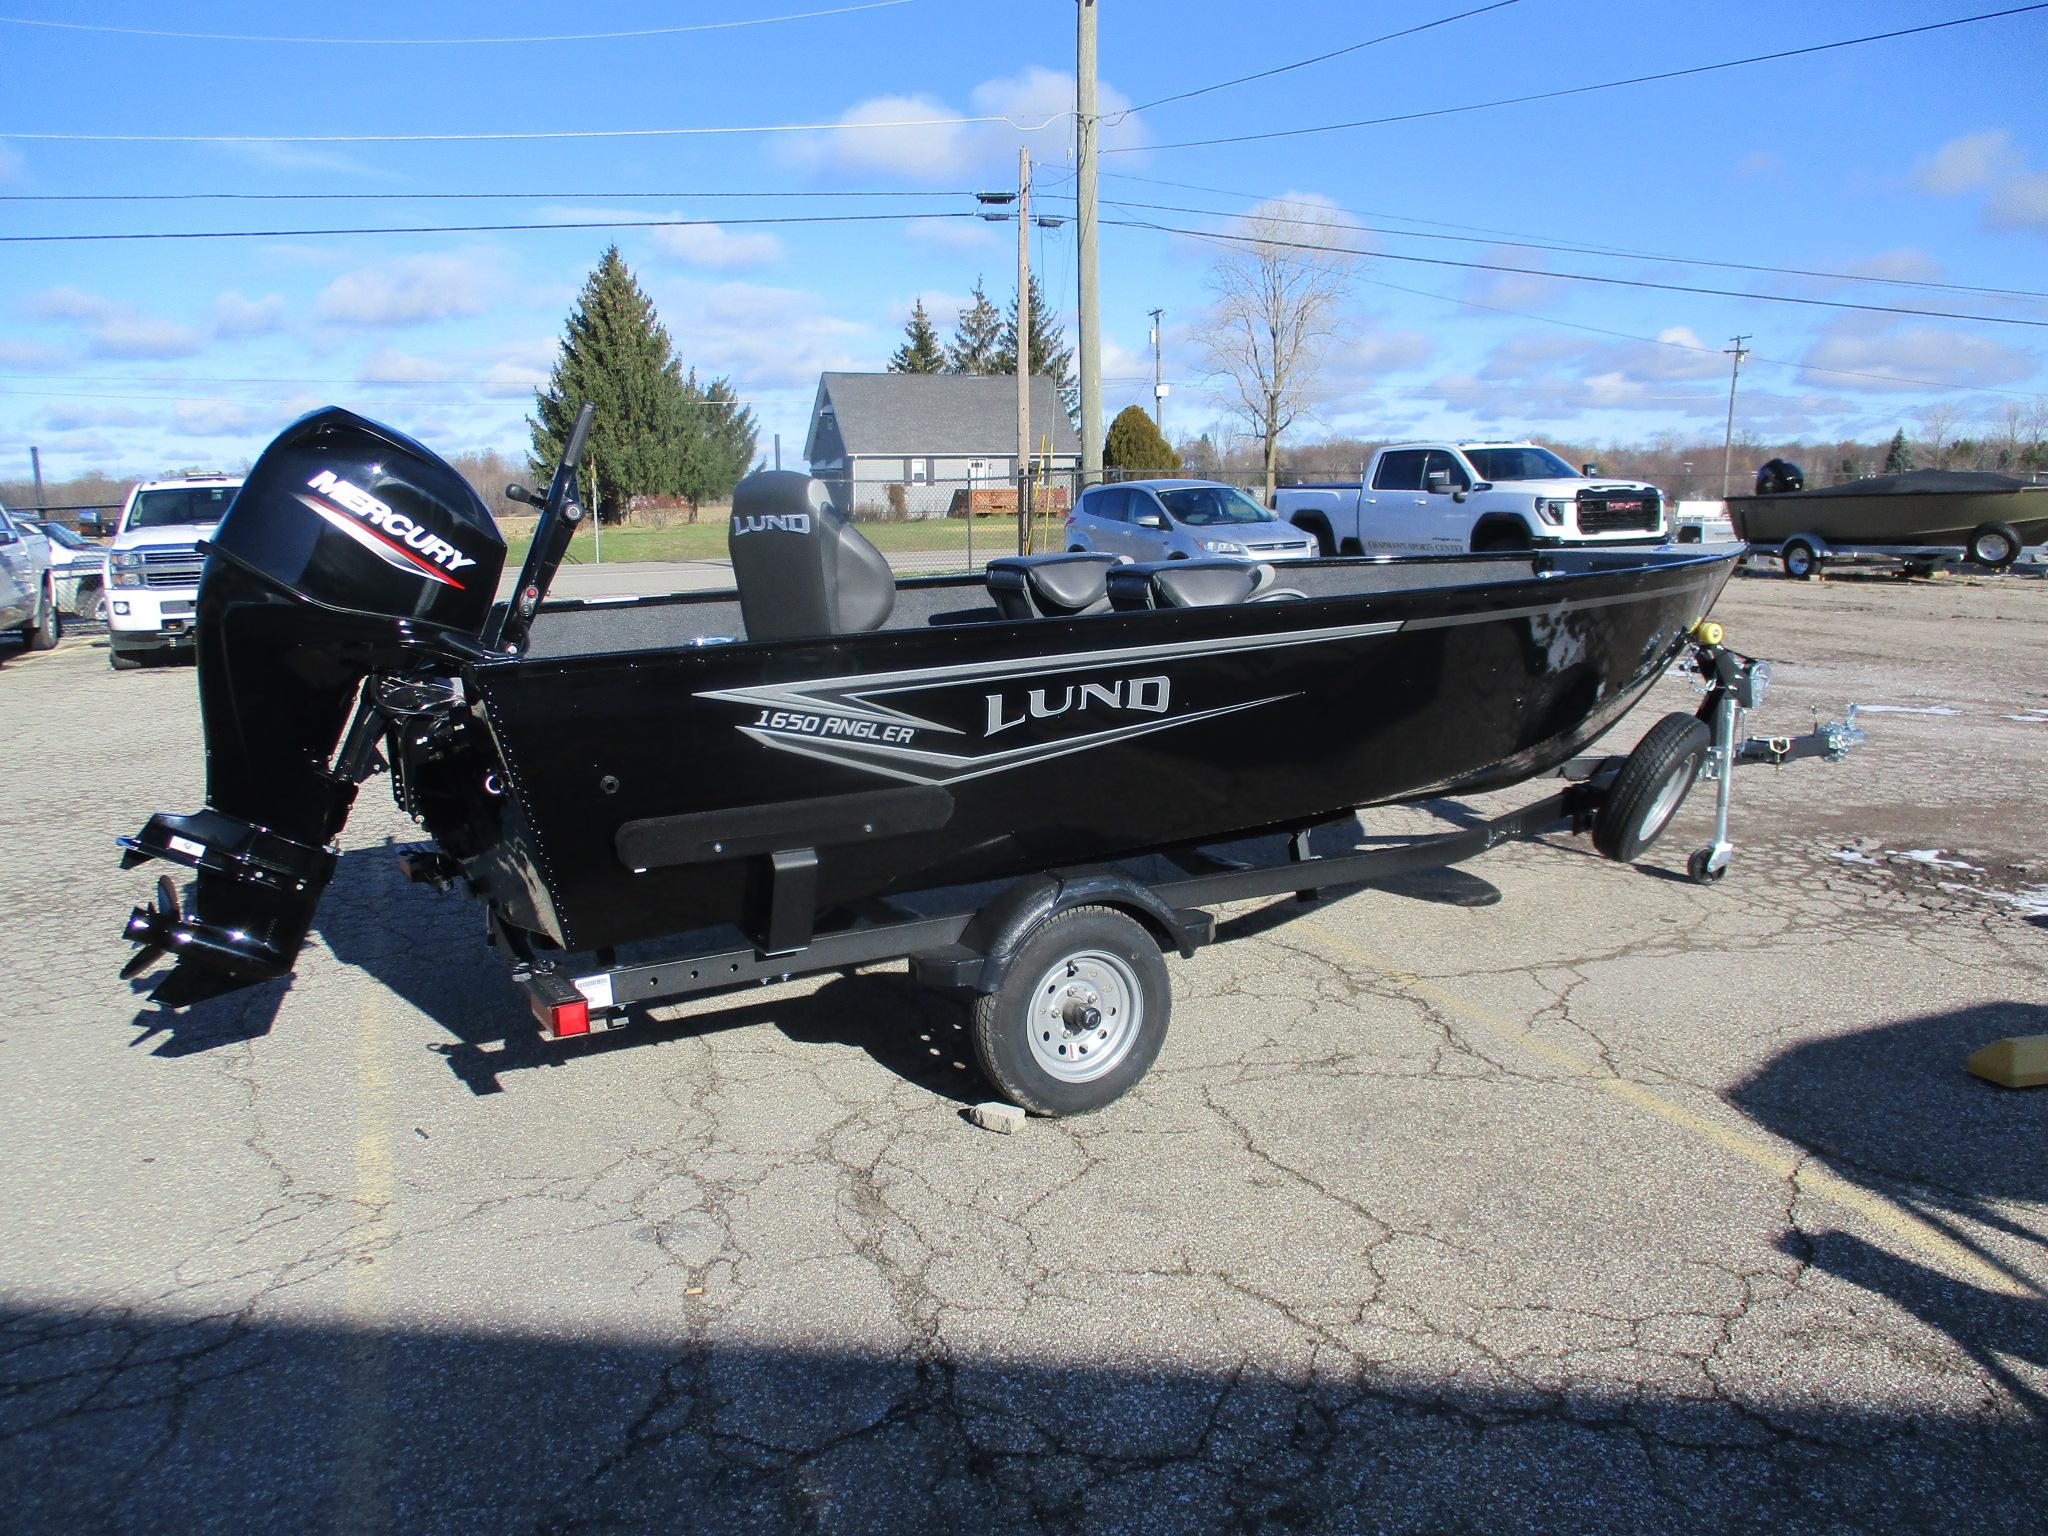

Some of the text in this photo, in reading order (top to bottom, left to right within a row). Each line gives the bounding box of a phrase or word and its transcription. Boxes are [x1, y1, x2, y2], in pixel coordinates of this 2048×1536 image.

[307, 470, 477, 571] MERCURY
[733, 514, 811, 536] LUND
[754, 710, 916, 744] 1650 ANGLER
[984, 675, 1171, 738] LUND
